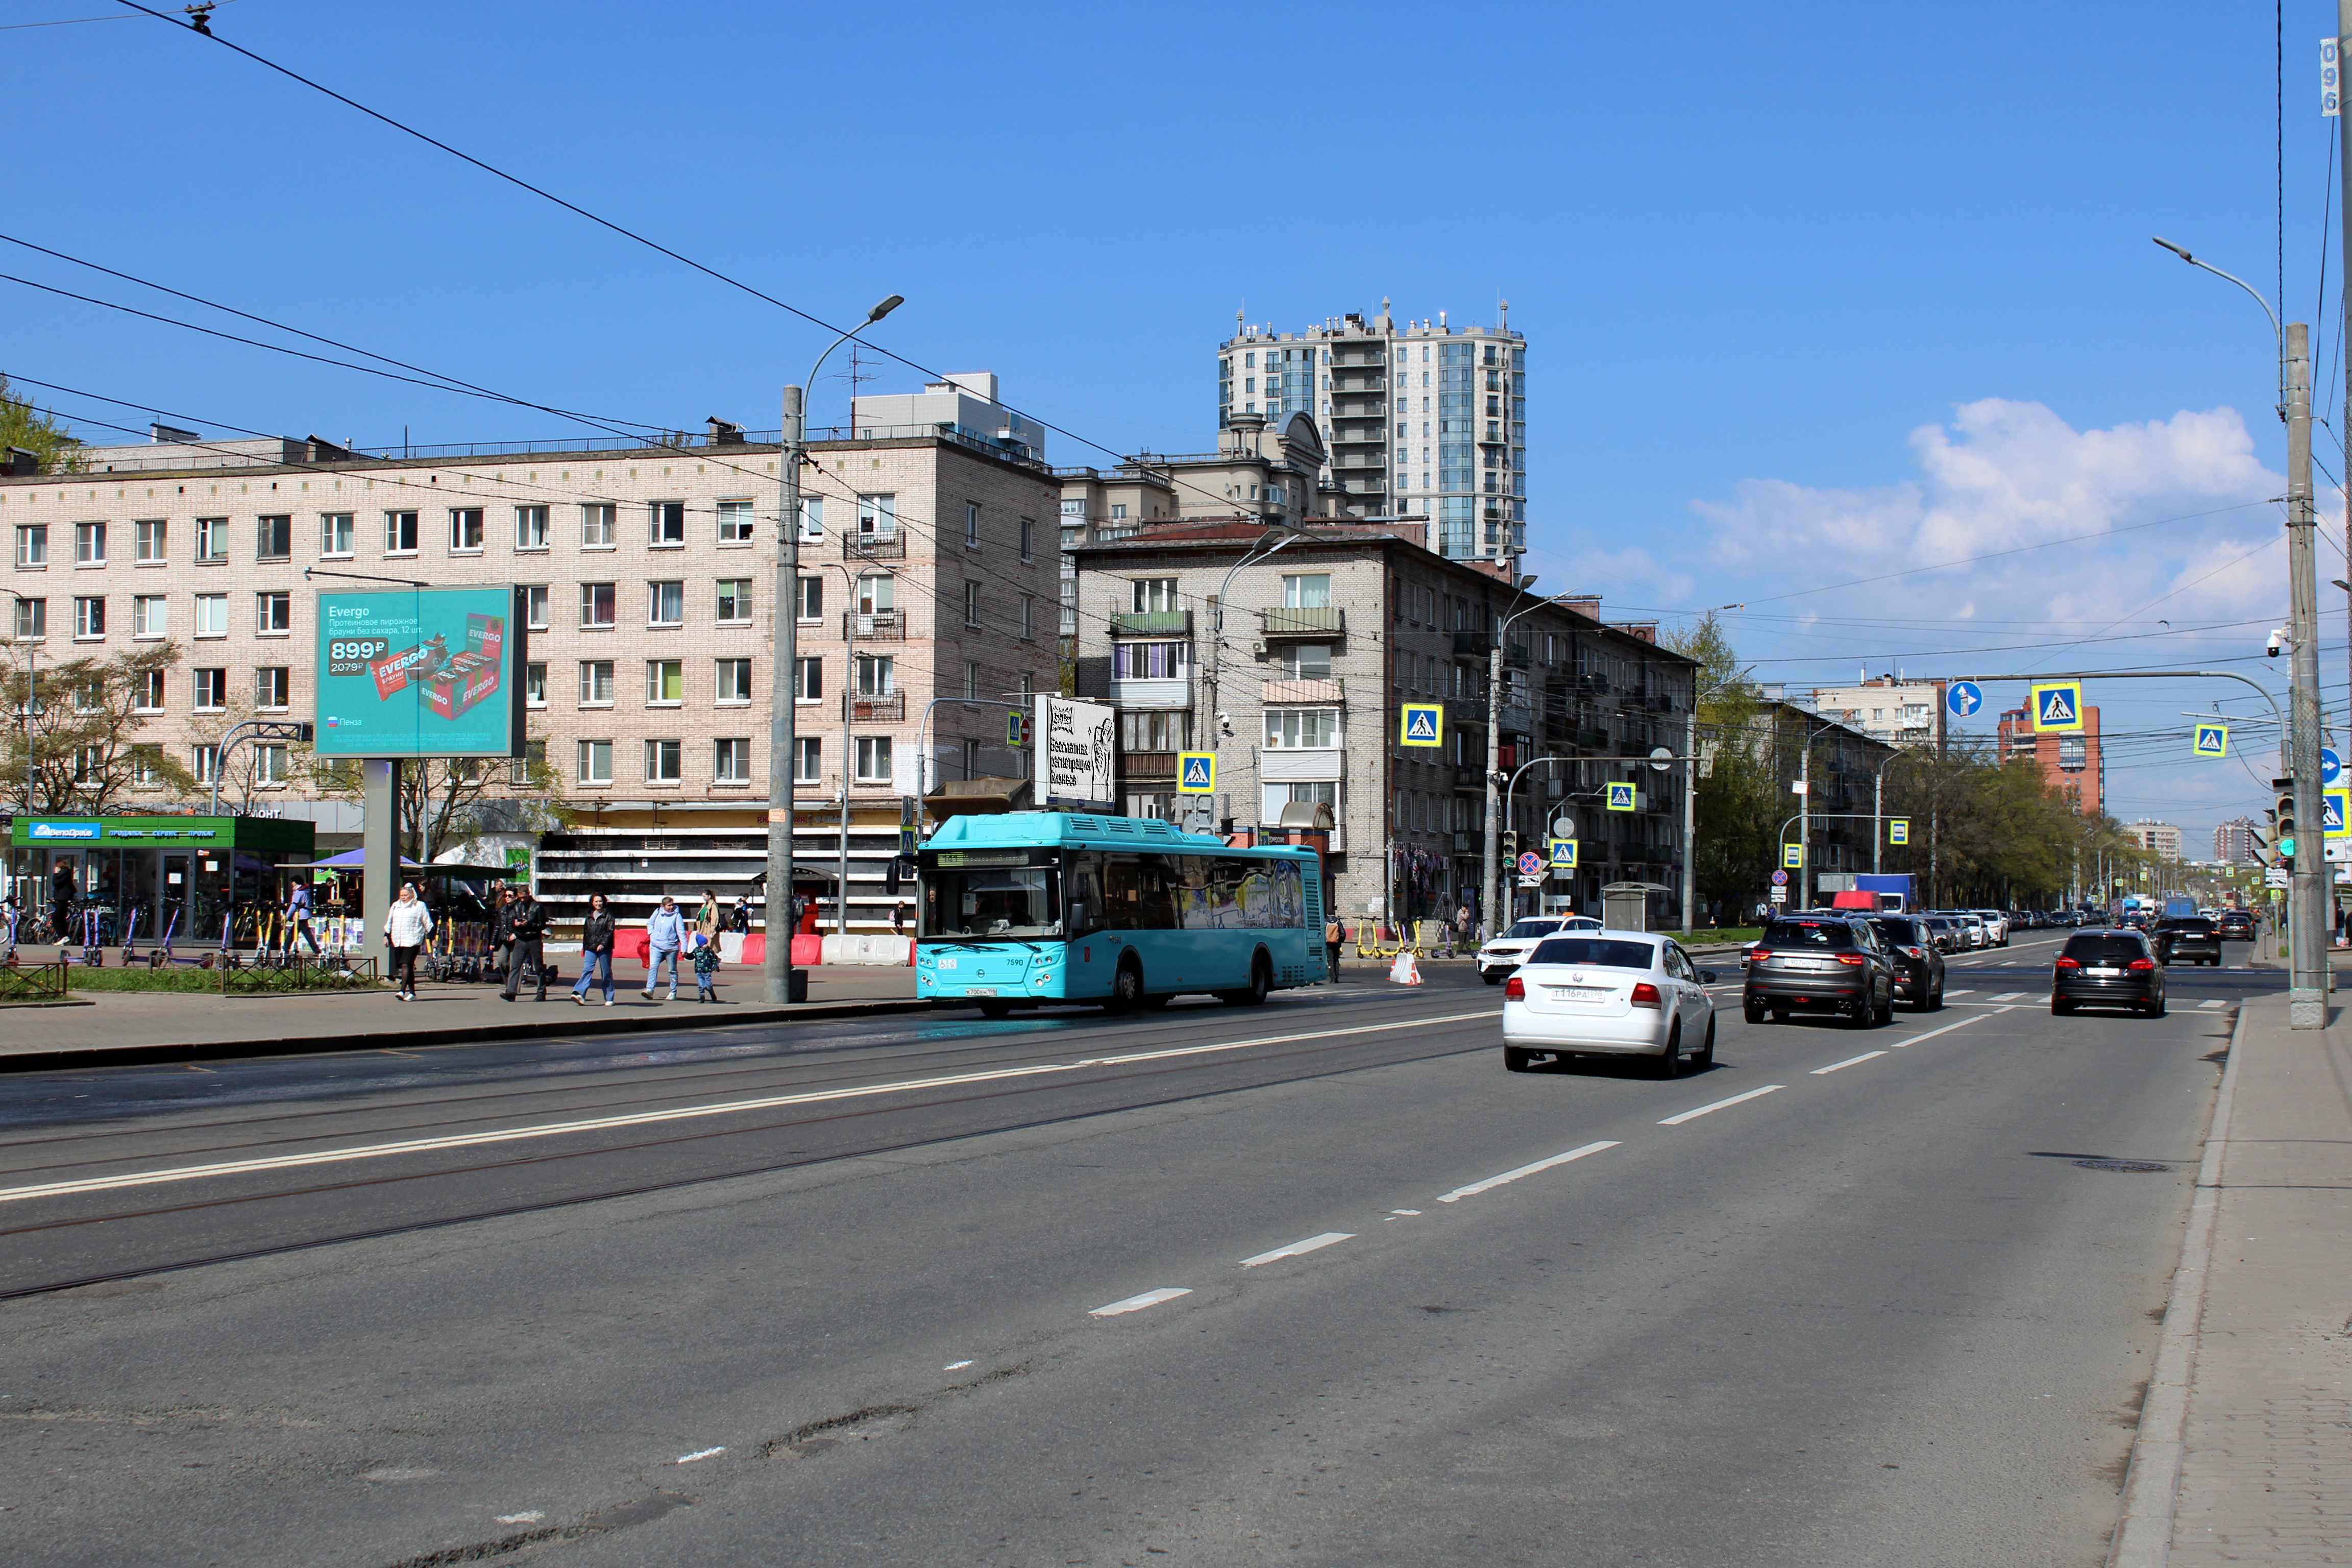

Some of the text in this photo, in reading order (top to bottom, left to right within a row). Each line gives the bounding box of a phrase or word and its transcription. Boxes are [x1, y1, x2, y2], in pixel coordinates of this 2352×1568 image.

[2323, 44, 2337, 111] 096
[329, 606, 370, 619] Evergo
[380, 618, 418, 626] пирожное
[469, 629, 501, 642] EVERGO
[379, 648, 428, 678] EVERGO
[382, 670, 404, 684] БРАУНИ
[422, 687, 448, 705] EVERGO
[462, 676, 494, 703] EVERGO
[1555, 989, 1587, 998] Т116РА
